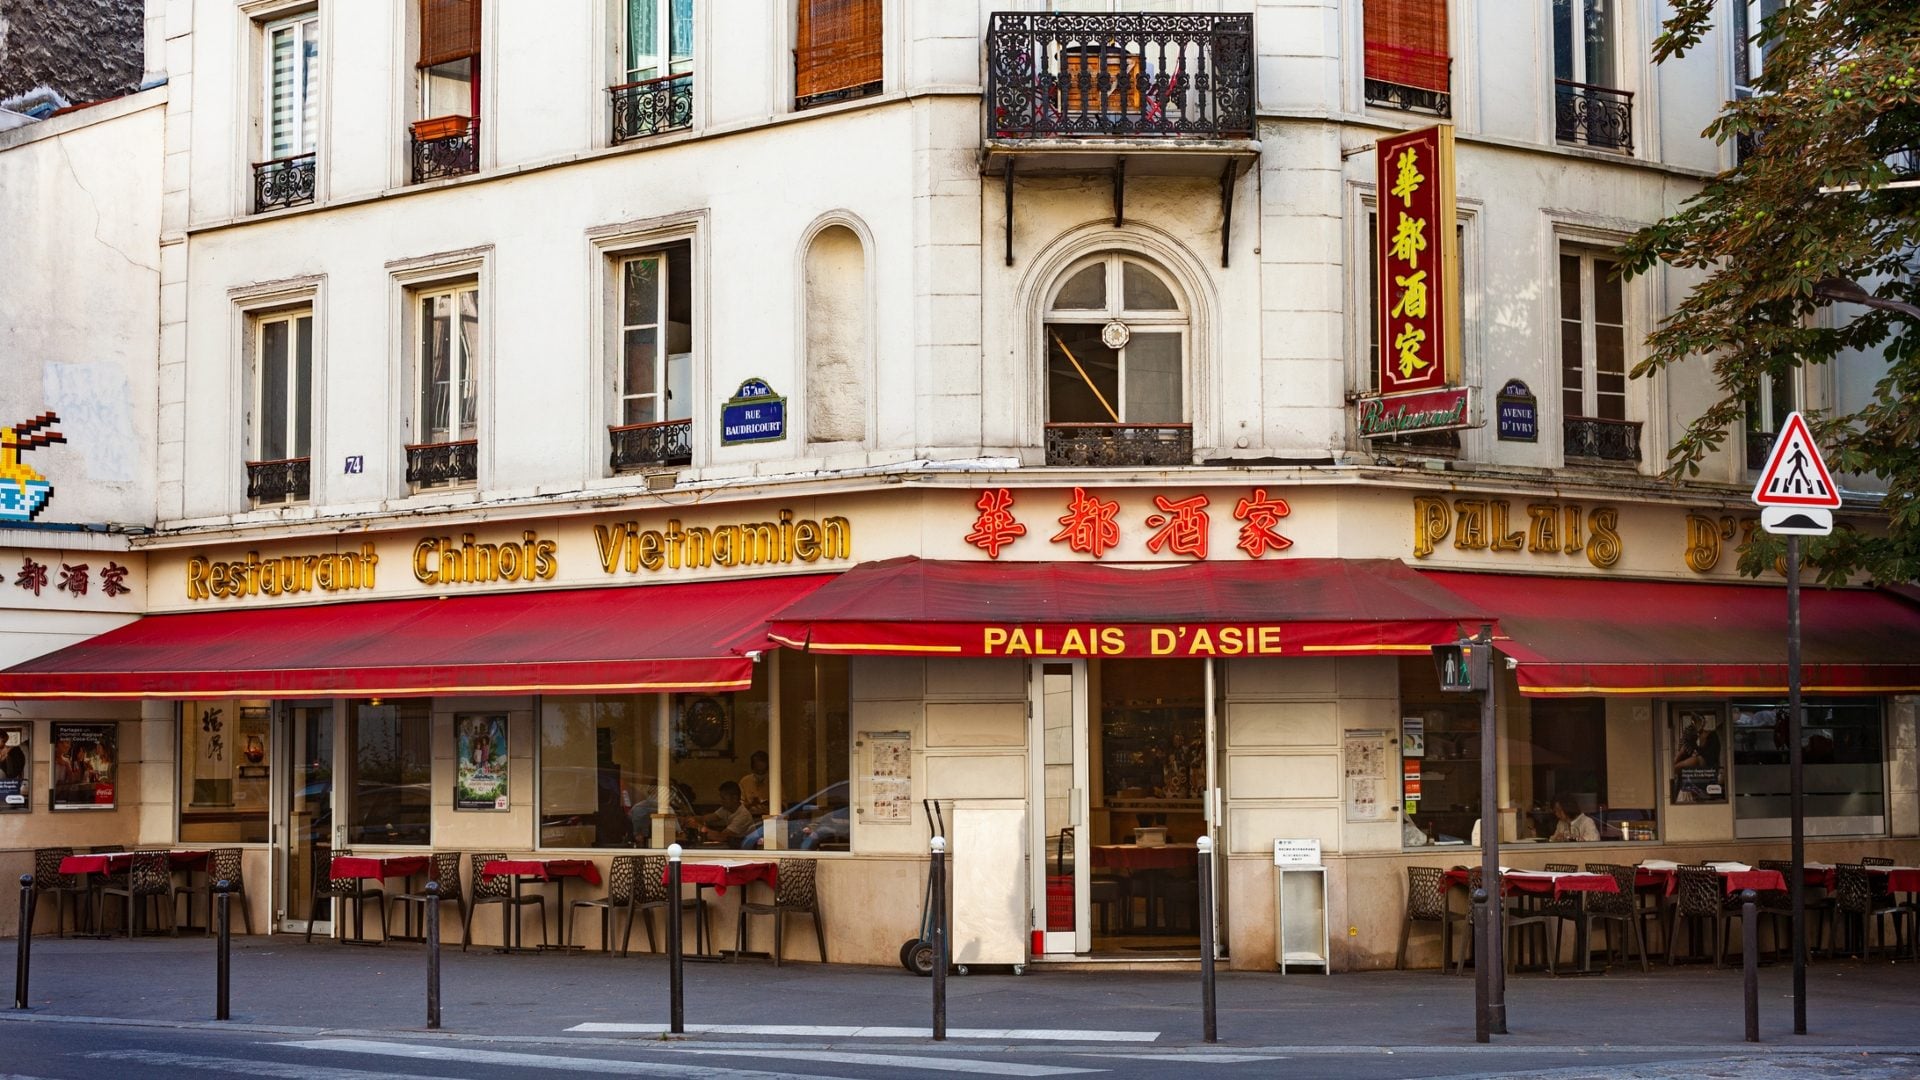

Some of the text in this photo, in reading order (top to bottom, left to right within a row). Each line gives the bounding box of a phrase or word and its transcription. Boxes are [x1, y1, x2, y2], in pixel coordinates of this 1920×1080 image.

[1388, 147, 1429, 378] 華都酒家
[726, 422, 781, 436] BAUDRICOURT
[745, 410, 760, 420] RUE
[1360, 397, 1464, 432] Restaurant
[1502, 408, 1532, 418] AVENUE
[1502, 421, 1533, 432] D'IVRY
[347, 457, 361, 473] 74
[964, 487, 1294, 559] 華都酒家
[1413, 495, 1623, 569] PALAIS
[187, 509, 851, 600] Restaurant Chinois Vietnamien
[0, 557, 131, 597] 都酒家
[984, 626, 1282, 656] PALAIS D'ASIE
